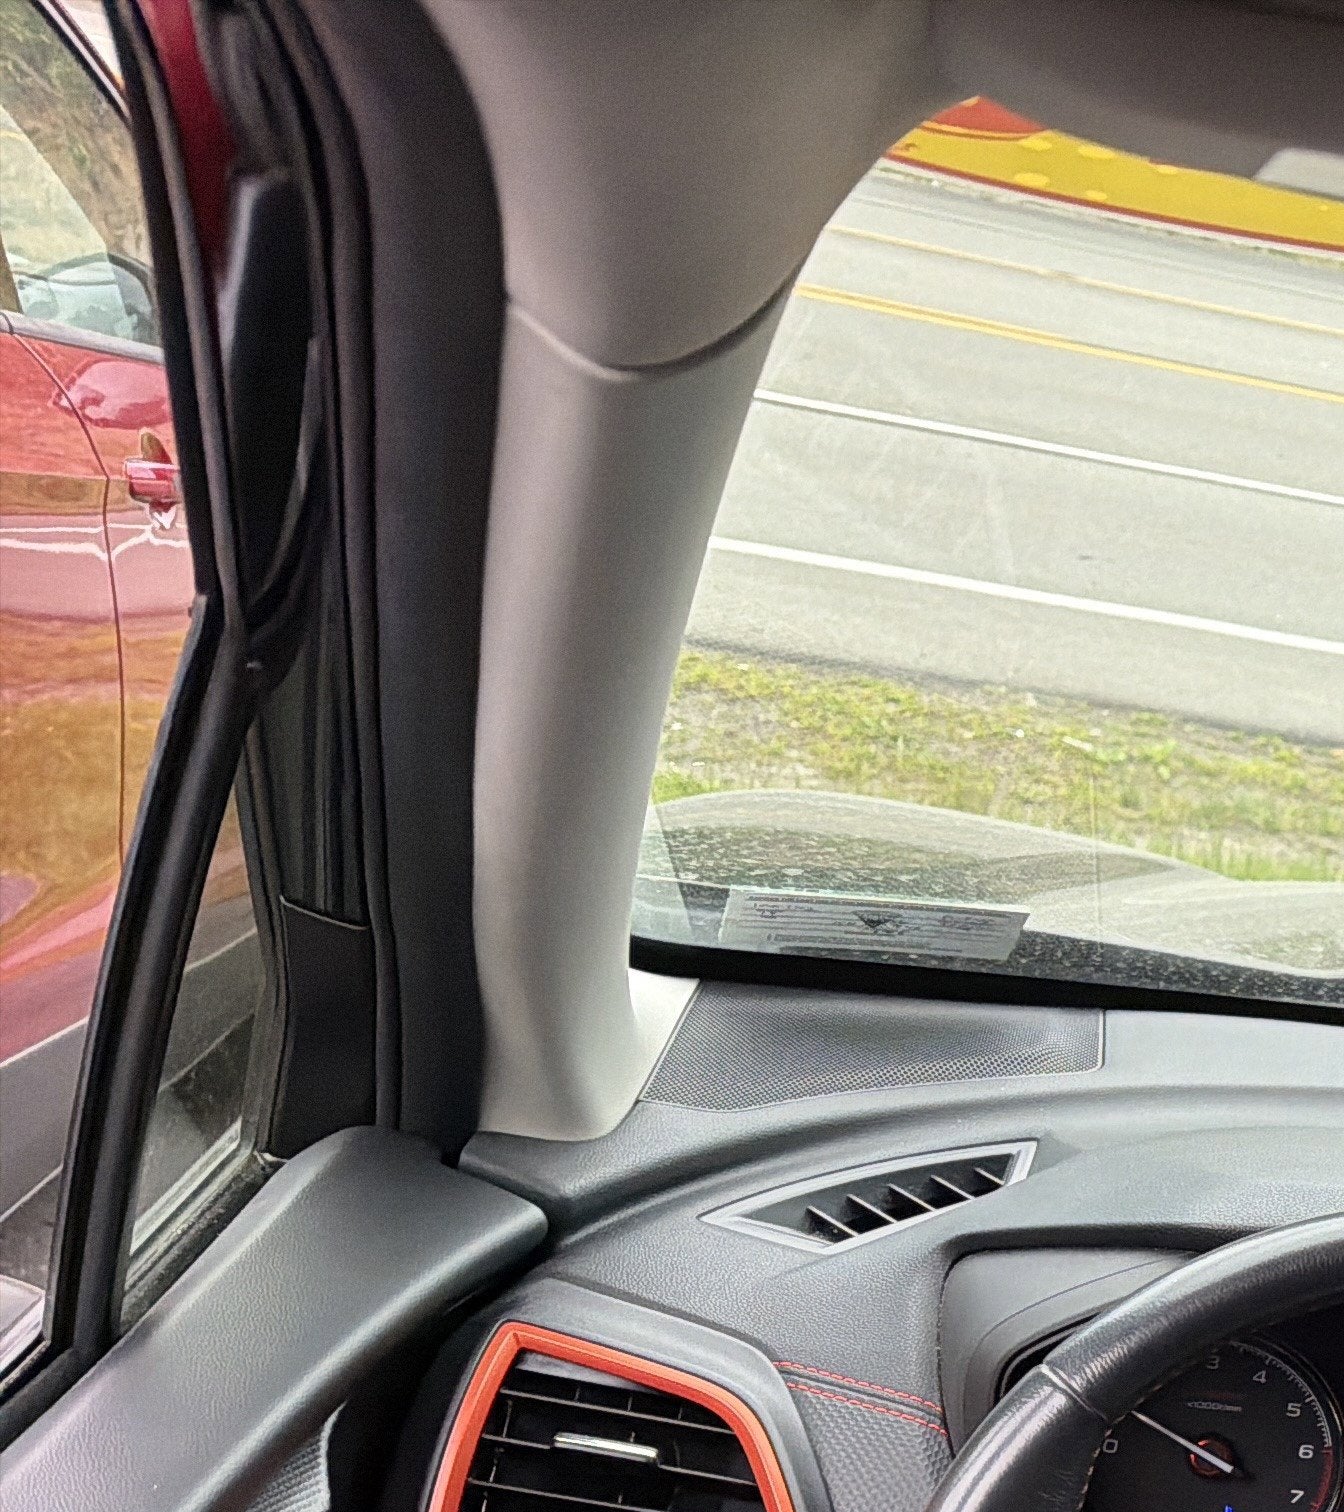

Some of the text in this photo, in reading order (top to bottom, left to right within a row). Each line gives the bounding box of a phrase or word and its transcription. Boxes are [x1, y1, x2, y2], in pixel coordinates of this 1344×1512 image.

[1252, 1370, 1267, 1384] 4
[1286, 1402, 1301, 1417] 5
[1102, 1438, 1118, 1454] 0
[1299, 1444, 1314, 1459] 6
[1290, 1489, 1305, 1504] 7
